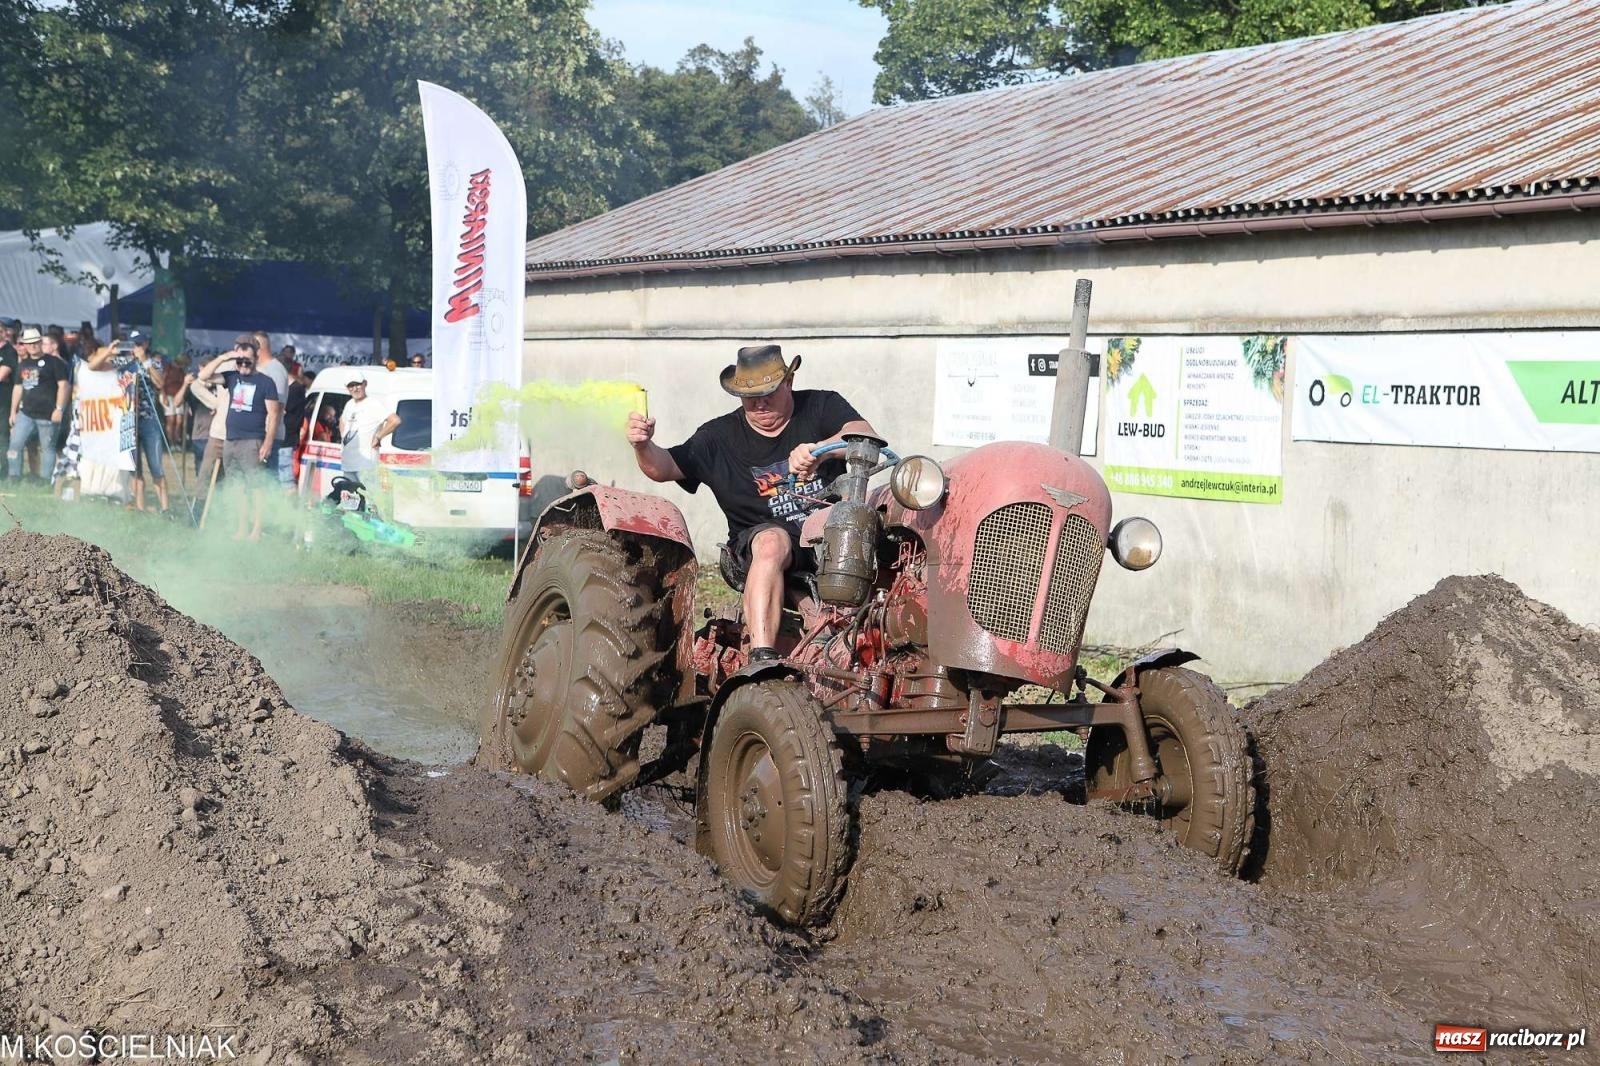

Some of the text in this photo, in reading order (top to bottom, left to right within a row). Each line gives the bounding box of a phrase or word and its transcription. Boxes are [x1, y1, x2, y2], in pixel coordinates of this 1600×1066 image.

[1362, 384, 1481, 406] EL-TRAKTOR
[1118, 422, 1165, 438] LEW-BUD
[1181, 478, 1277, 496] andrzejlewczuk@interia.pl
